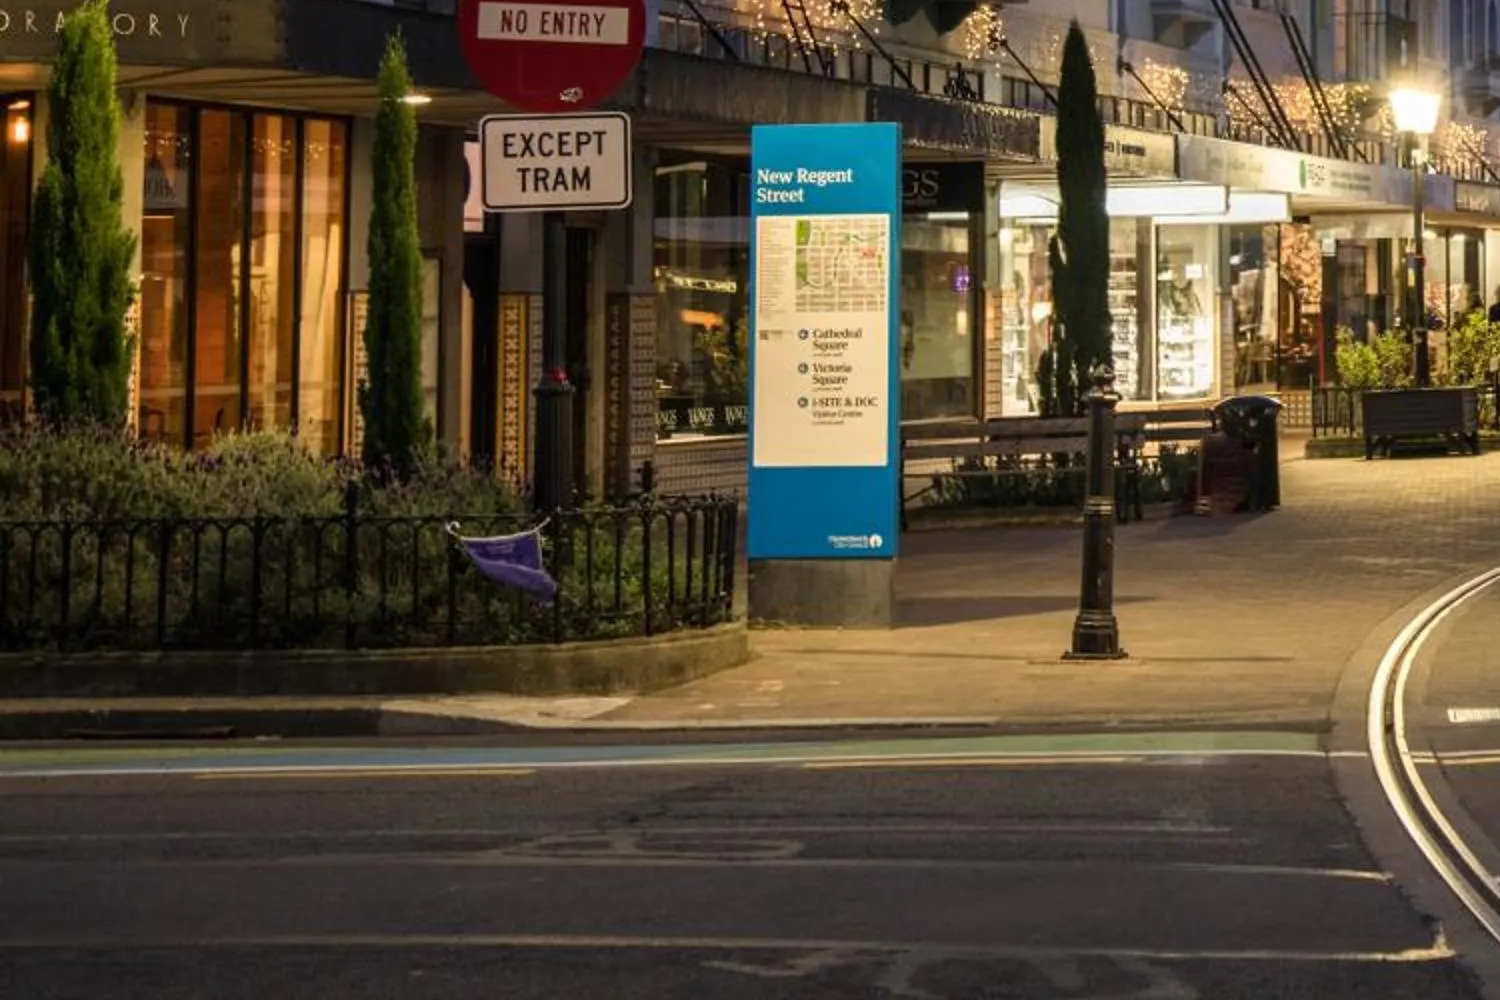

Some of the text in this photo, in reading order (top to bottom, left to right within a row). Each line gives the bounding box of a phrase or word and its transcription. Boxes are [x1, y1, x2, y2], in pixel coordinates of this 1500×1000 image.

[500, 10, 607, 37] NO ENTRY
[502, 130, 608, 159] EXCEPT
[516, 166, 591, 193] TRAM
[757, 167, 853, 188] New Regent
[757, 186, 805, 204] Street
[812, 327, 863, 340] Cathedral
[812, 340, 849, 353] Square
[811, 375, 849, 387] Square
